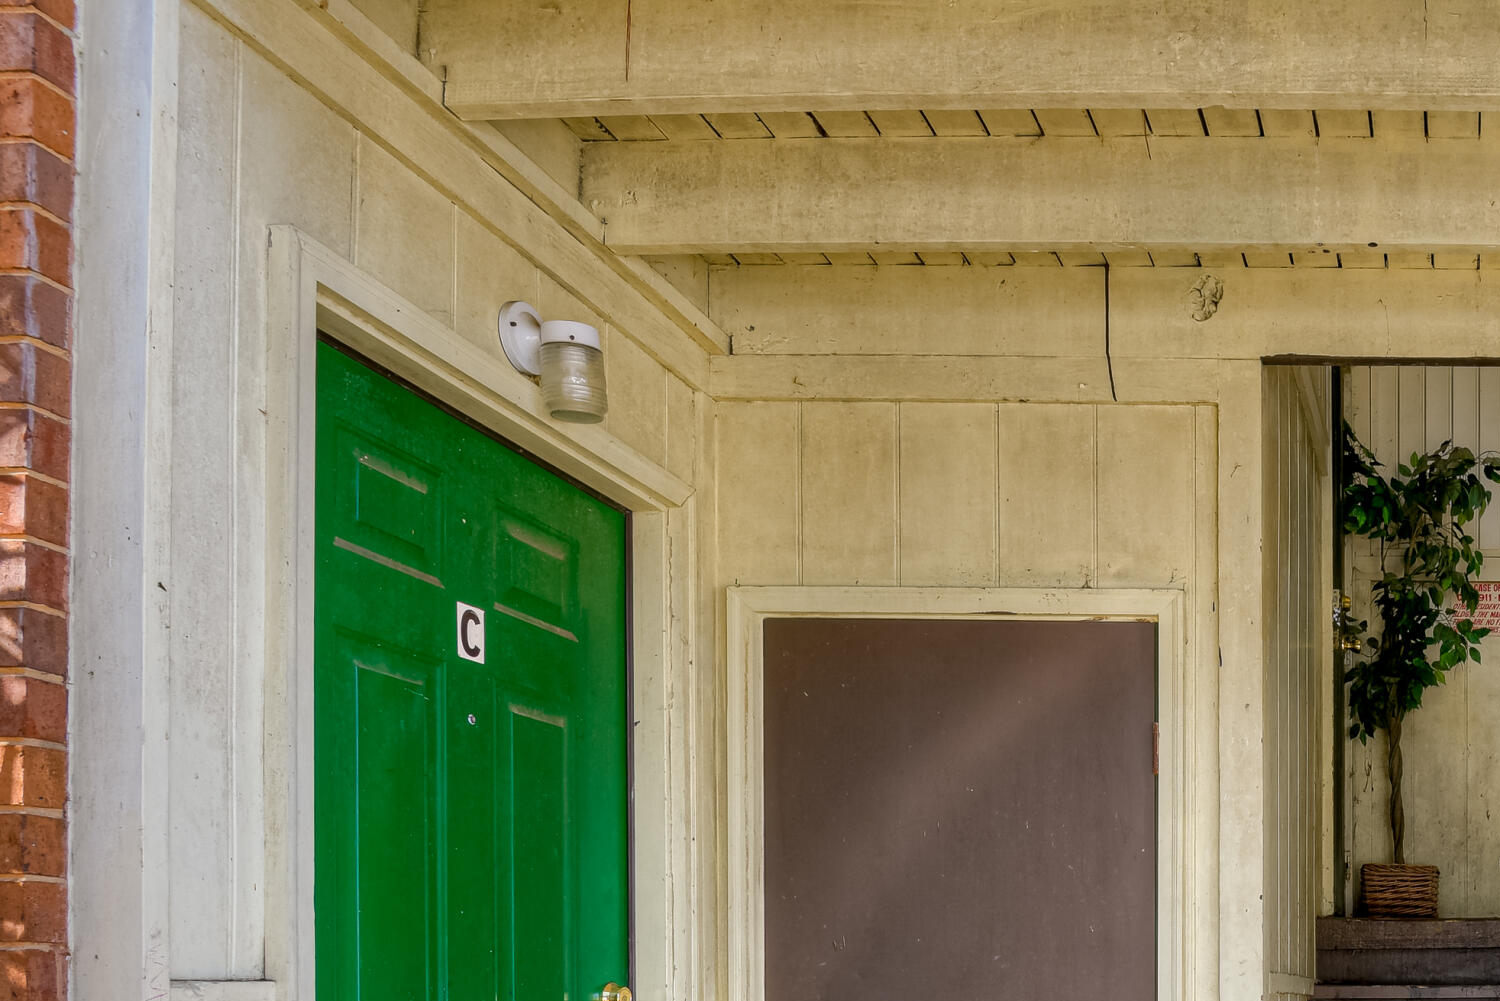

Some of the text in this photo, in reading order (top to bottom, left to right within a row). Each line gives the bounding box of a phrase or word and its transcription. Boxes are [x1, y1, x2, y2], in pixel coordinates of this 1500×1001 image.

[1474, 584, 1492, 592] CASE
[1493, 584, 1500, 592] OF
[1479, 594, 1492, 602] 911
[461, 609, 480, 657] C
